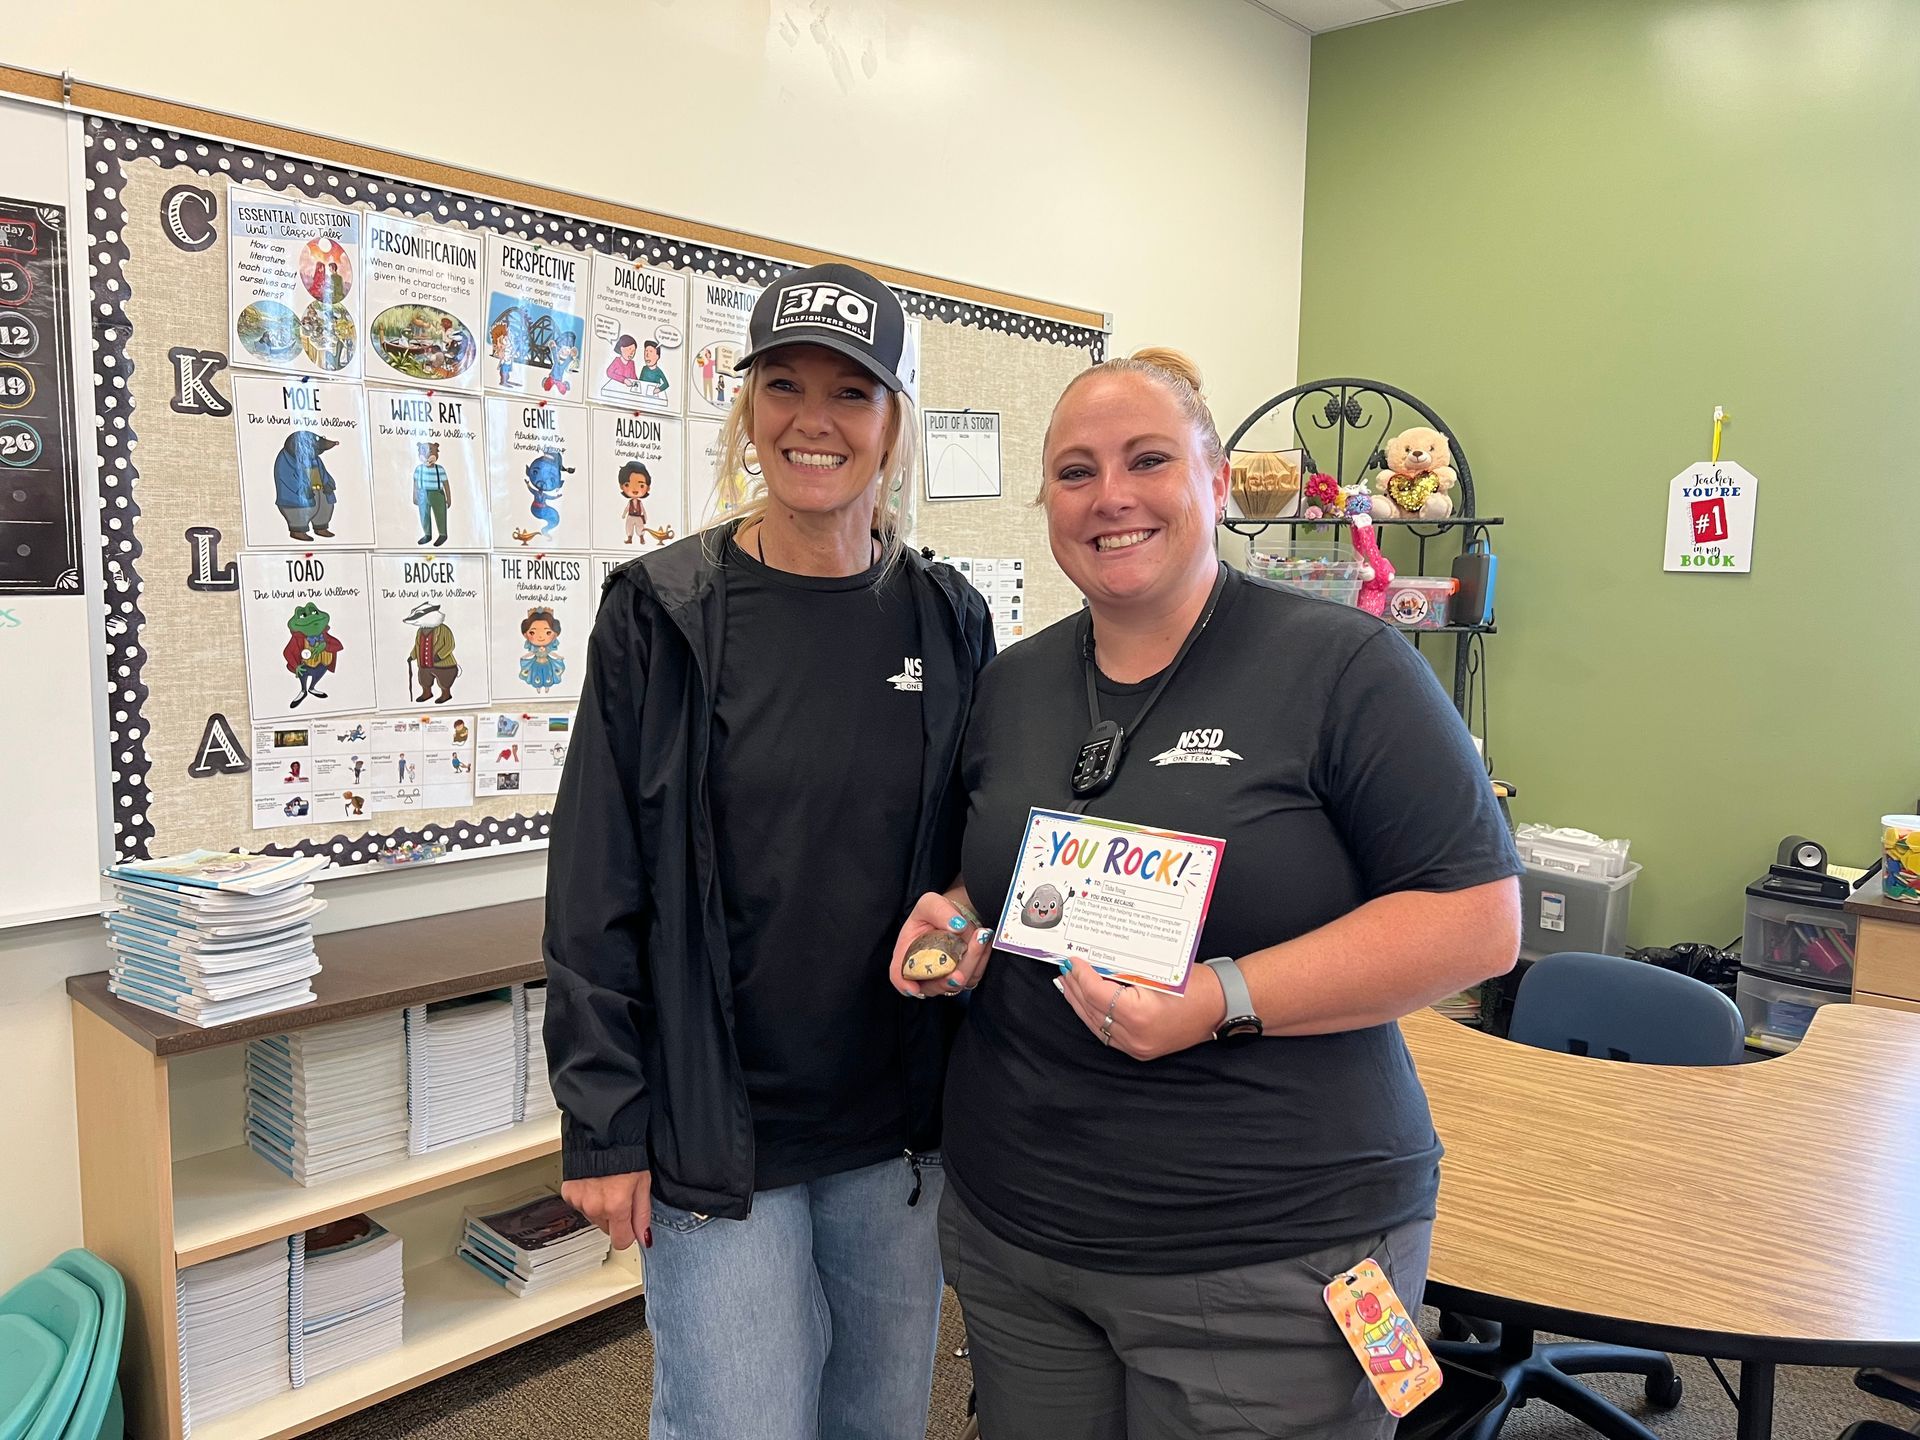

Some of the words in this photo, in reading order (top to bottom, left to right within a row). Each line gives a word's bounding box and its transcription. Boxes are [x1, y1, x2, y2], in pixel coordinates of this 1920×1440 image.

[165, 188, 213, 248] C
[239, 208, 296, 224] ESSENTIAL
[300, 212, 351, 227] QUESTION
[246, 224, 267, 235] Unit
[281, 226, 315, 238] Classic
[318, 228, 342, 240] Tales
[250, 240, 268, 249] How
[371, 228, 476, 269] PERSONIFICATION
[250, 252, 285, 265] literature
[503, 245, 575, 283] PERSPECTIVE
[238, 262, 260, 272] teach
[274, 268, 297, 278] about
[370, 257, 393, 268] When
[408, 265, 433, 277] animal
[448, 273, 466, 285] thing
[468, 277, 475, 285] is
[501, 269, 514, 278] How
[516, 274, 544, 285] someone
[1, 272, 18, 291] 5
[240, 275, 278, 287] ourselves
[281, 282, 296, 290] and
[374, 272, 396, 281] given
[399, 275, 411, 284] the
[413, 277, 471, 296] characteristics
[614, 267, 666, 298] DIALOGUE
[252, 288, 284, 299] others?
[400, 288, 408, 296] of
[419, 292, 447, 303] person
[522, 295, 553, 309] something
[535, 288, 571, 301] experiences
[597, 294, 624, 305] characters
[605, 304, 630, 313] Quotation
[780, 315, 844, 326] BULLFIGHTERS
[846, 323, 866, 336] ONLY
[0, 326, 30, 346] 12
[172, 350, 228, 413] K
[283, 386, 321, 411] MOLE
[391, 399, 433, 422] WATER
[439, 402, 462, 424] RAT
[523, 408, 555, 430] GENIE
[248, 413, 264, 424] The
[267, 415, 290, 425] Wind
[321, 418, 357, 428] Willows
[930, 416, 948, 429] PLOT
[951, 416, 960, 429] OF
[963, 417, 968, 429] A
[971, 417, 993, 429] STORY
[379, 424, 393, 435] The
[396, 426, 416, 435] Wind
[444, 429, 476, 439] Willows
[514, 431, 539, 442] Aladdin
[541, 434, 553, 442] and
[616, 418, 661, 441] ALADDIN
[1, 433, 35, 455] 26
[616, 439, 639, 449] Aladdin
[615, 449, 645, 460] Wonderful
[1683, 487, 1741, 497] YOU'RE
[1696, 505, 1723, 535] #1
[189, 530, 236, 587] L
[1680, 555, 1735, 566] BOOK
[1707, 546, 1720, 558] my
[286, 559, 324, 582] TOAD
[404, 563, 454, 583] BADGER
[501, 559, 522, 579] THE
[528, 561, 580, 580] PRINCESS
[602, 562, 619, 579] TH
[253, 589, 269, 600] The
[272, 589, 294, 599] Wind
[325, 587, 360, 596] Willows
[382, 589, 396, 598] The
[399, 589, 419, 597] Wind
[446, 589, 477, 597] Willows
[517, 582, 542, 592] Aladdin
[515, 594, 549, 602] Wonderful
[905, 657, 922, 676] NS
[192, 716, 247, 775] A
[1177, 729, 1223, 748] NSSD
[1050, 831, 1099, 869] YOU
[1103, 837, 1193, 886] ROCK!
